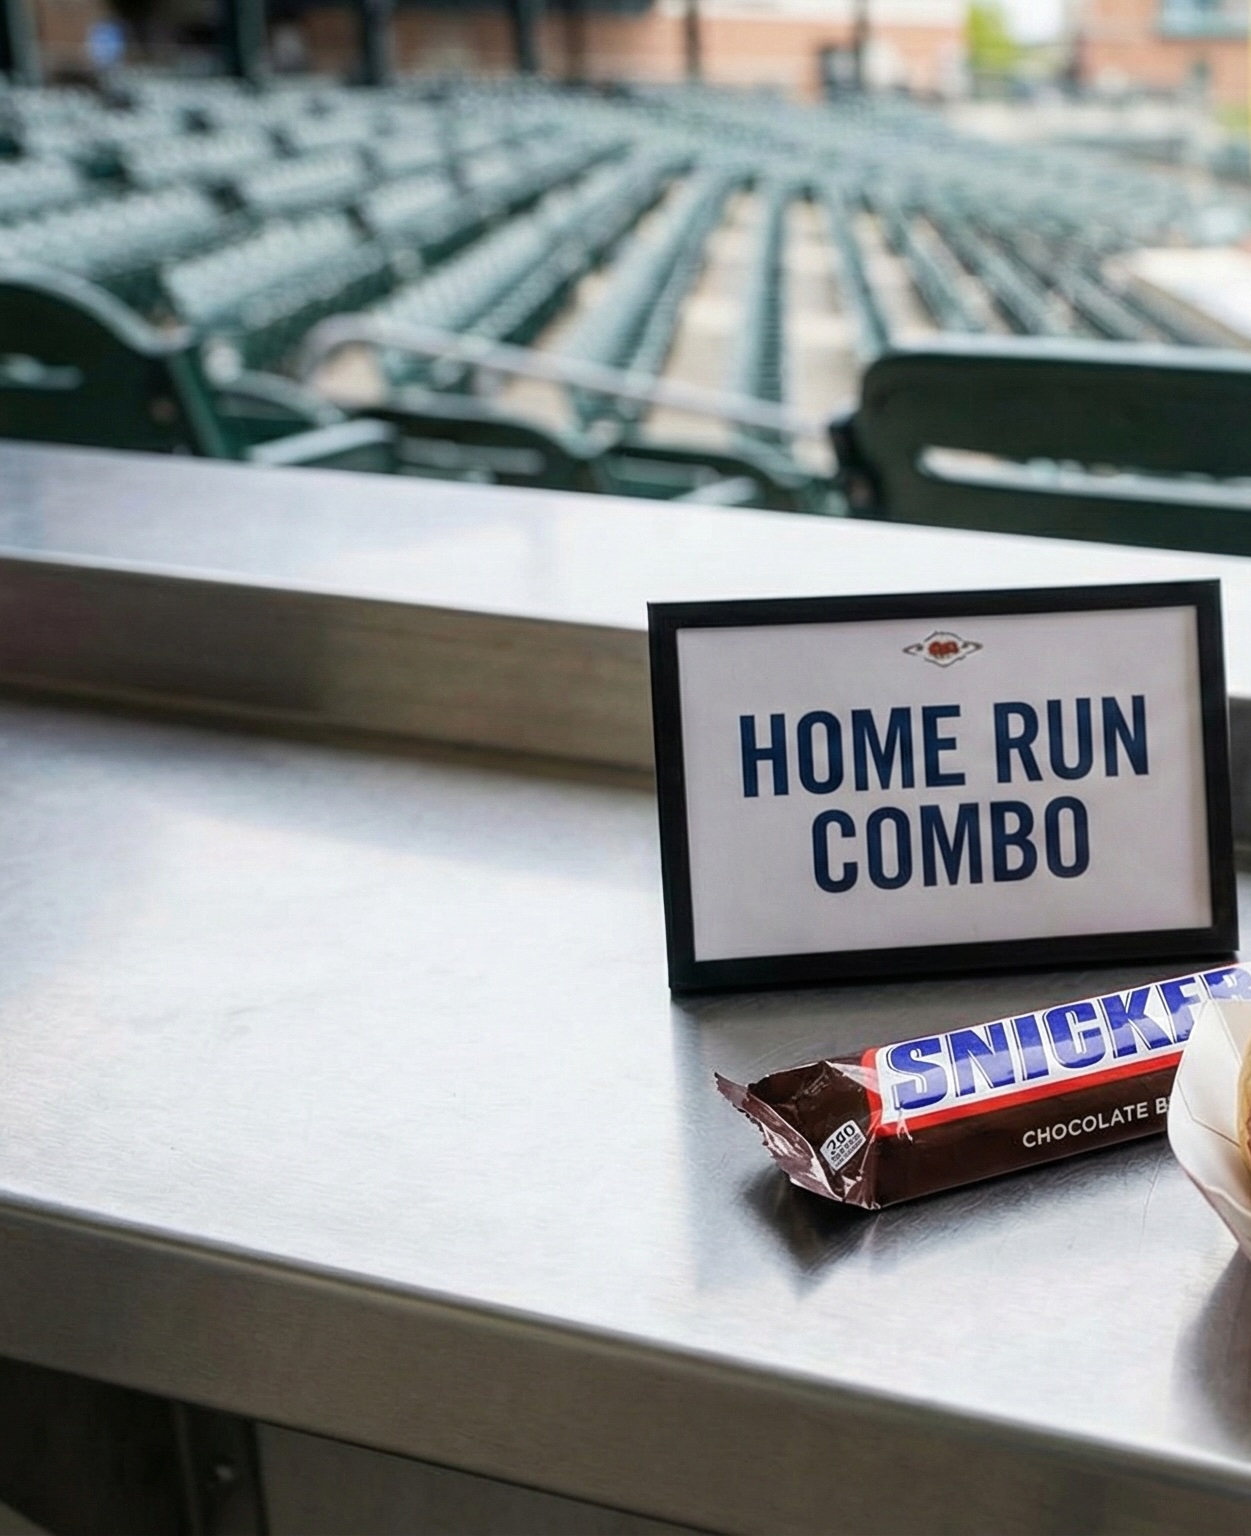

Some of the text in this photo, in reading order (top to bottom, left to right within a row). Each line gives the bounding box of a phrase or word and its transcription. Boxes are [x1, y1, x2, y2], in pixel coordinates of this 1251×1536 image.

[739, 694, 1150, 798] HOME RUN
[812, 796, 1091, 893] COMBO
[1022, 1101, 1149, 1149] CHOCOLATE
